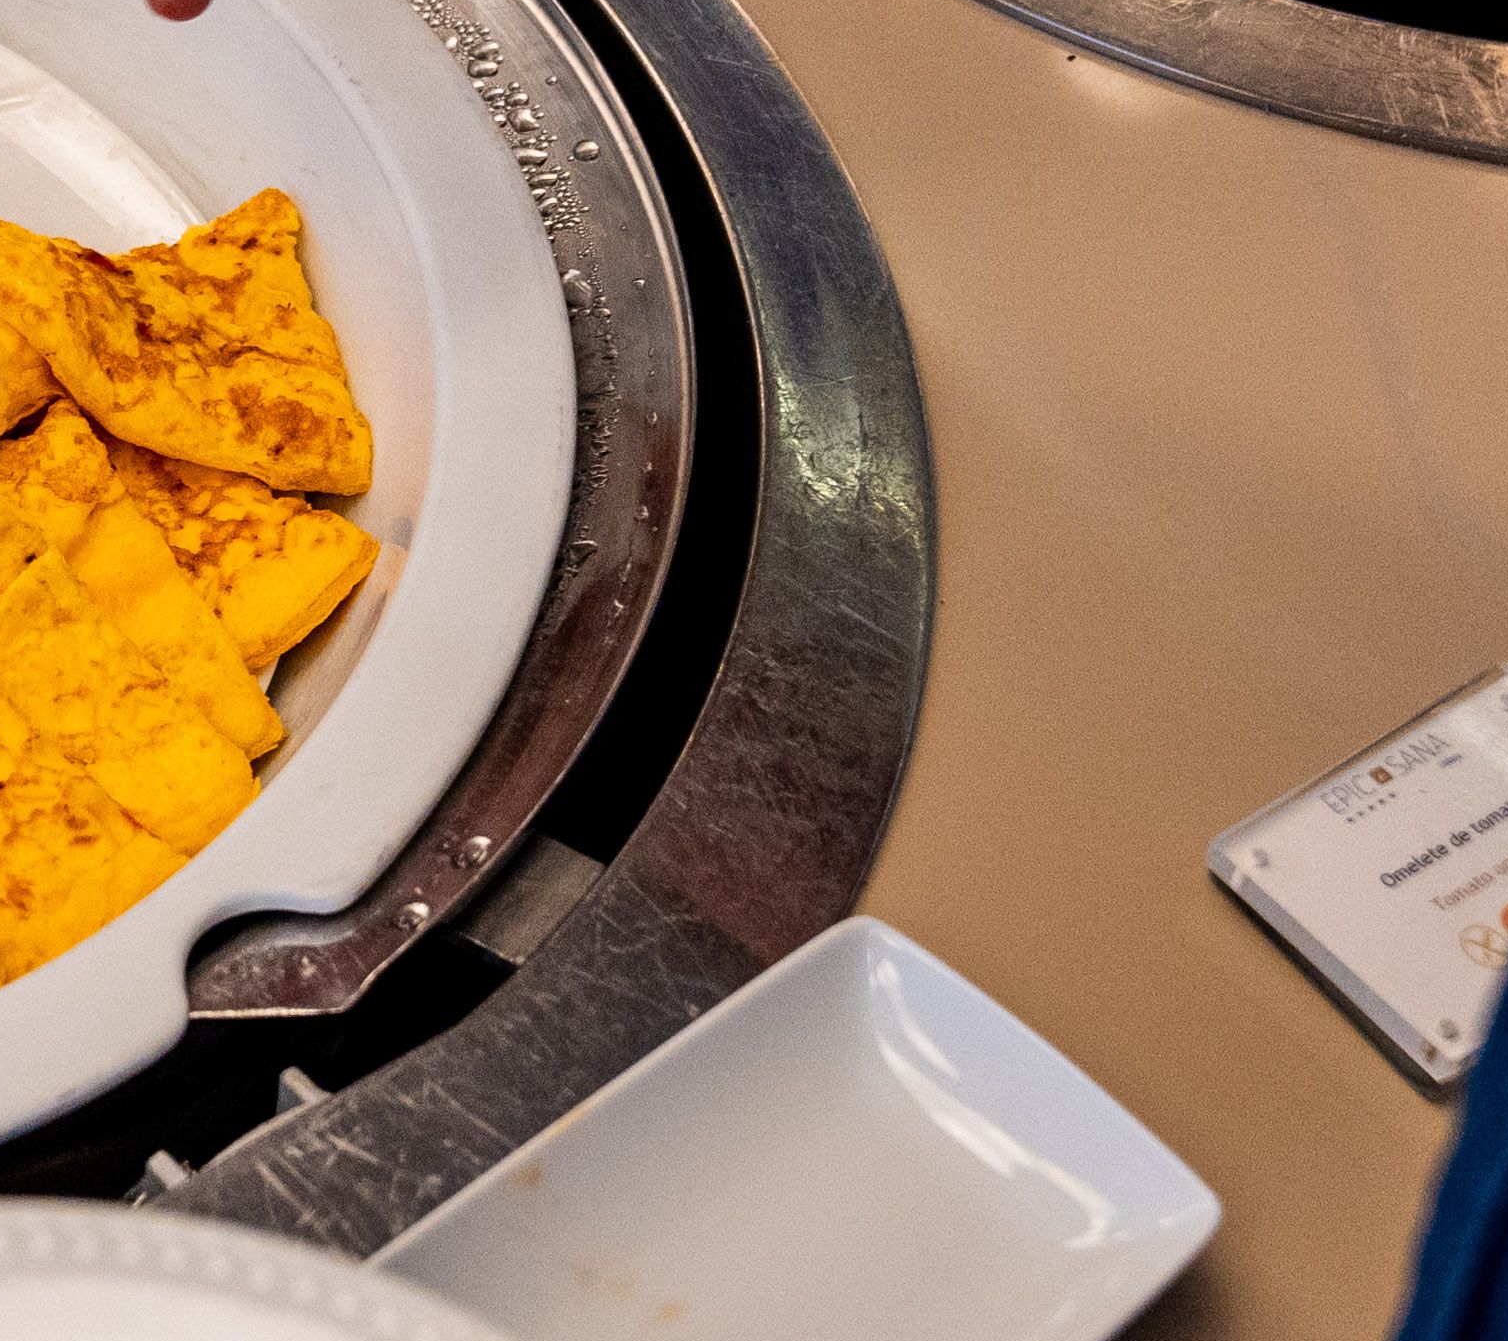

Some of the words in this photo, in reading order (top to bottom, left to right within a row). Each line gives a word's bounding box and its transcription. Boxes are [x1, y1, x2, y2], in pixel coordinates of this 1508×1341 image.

[1320, 774, 1377, 815] EPIC
[1384, 733, 1452, 777] SANA
[1380, 844, 1449, 888] Omelete
[1449, 831, 1472, 848] de
[1430, 871, 1496, 911] Tomato
